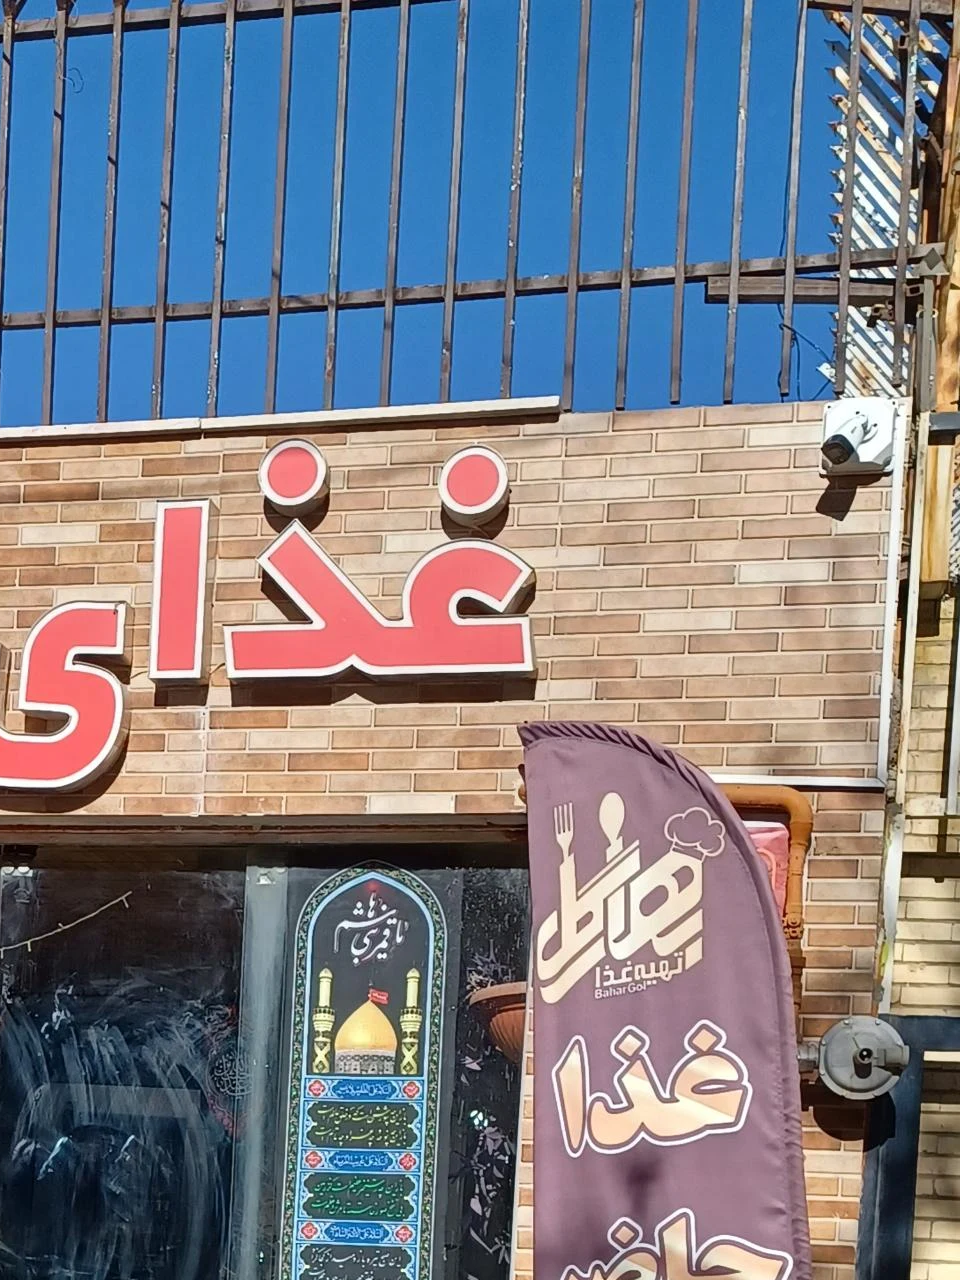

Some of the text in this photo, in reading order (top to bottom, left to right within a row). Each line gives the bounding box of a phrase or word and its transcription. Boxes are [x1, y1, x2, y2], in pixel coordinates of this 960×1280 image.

[595, 951, 684, 988] تهیه غذا
[551, 1019, 754, 1158] غذا
